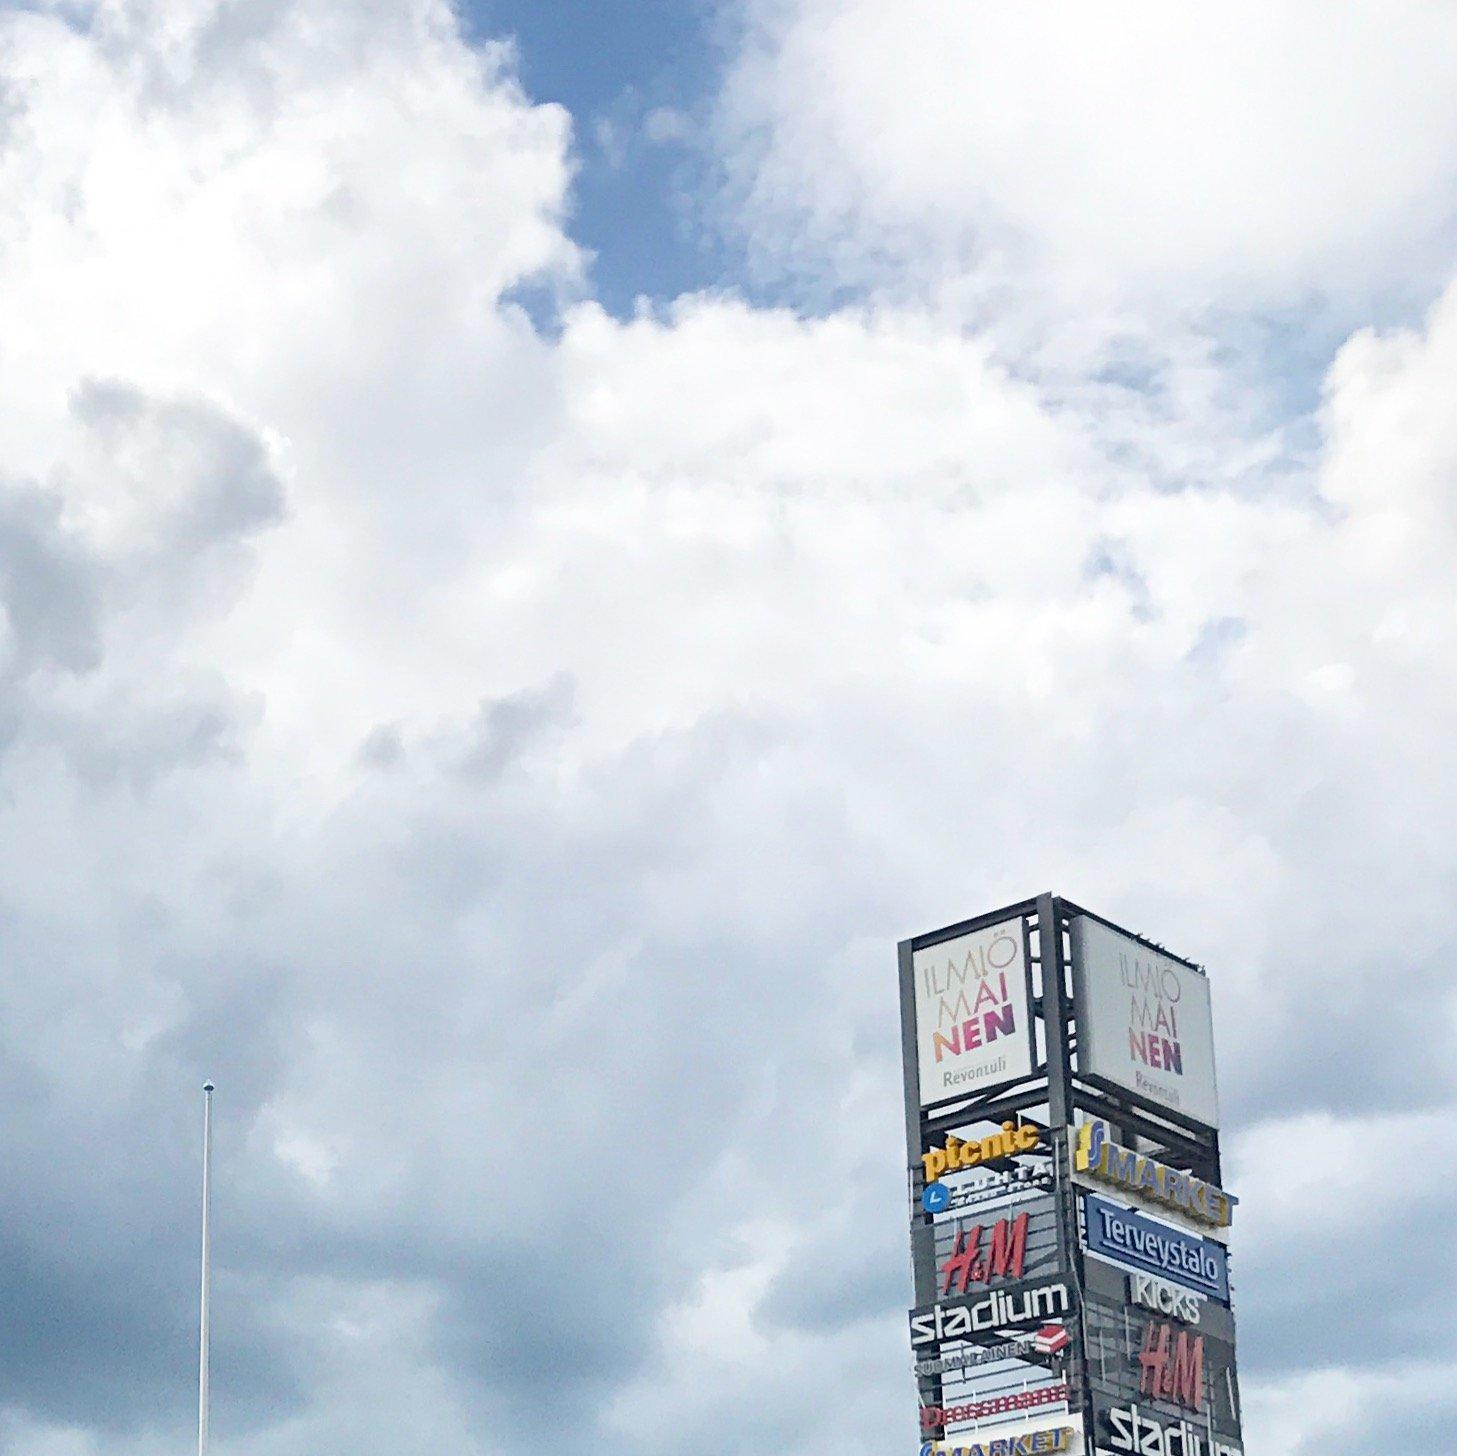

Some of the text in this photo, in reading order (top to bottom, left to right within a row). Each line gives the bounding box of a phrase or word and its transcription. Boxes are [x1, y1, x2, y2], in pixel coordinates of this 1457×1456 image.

[924, 929, 1018, 998] ILMIÖ
[932, 1003, 1016, 1063] NEN
[1129, 1026, 1183, 1076] NEN
[943, 1056, 1007, 1088] Revontuli
[920, 1120, 1040, 1183] picnic
[940, 1211, 1031, 1297] H&M
[1098, 1207, 1219, 1281] Terveystalo
[910, 1283, 1070, 1346] stadium
[1131, 1273, 1204, 1325] KICKS
[1138, 1320, 1206, 1411] H&M
